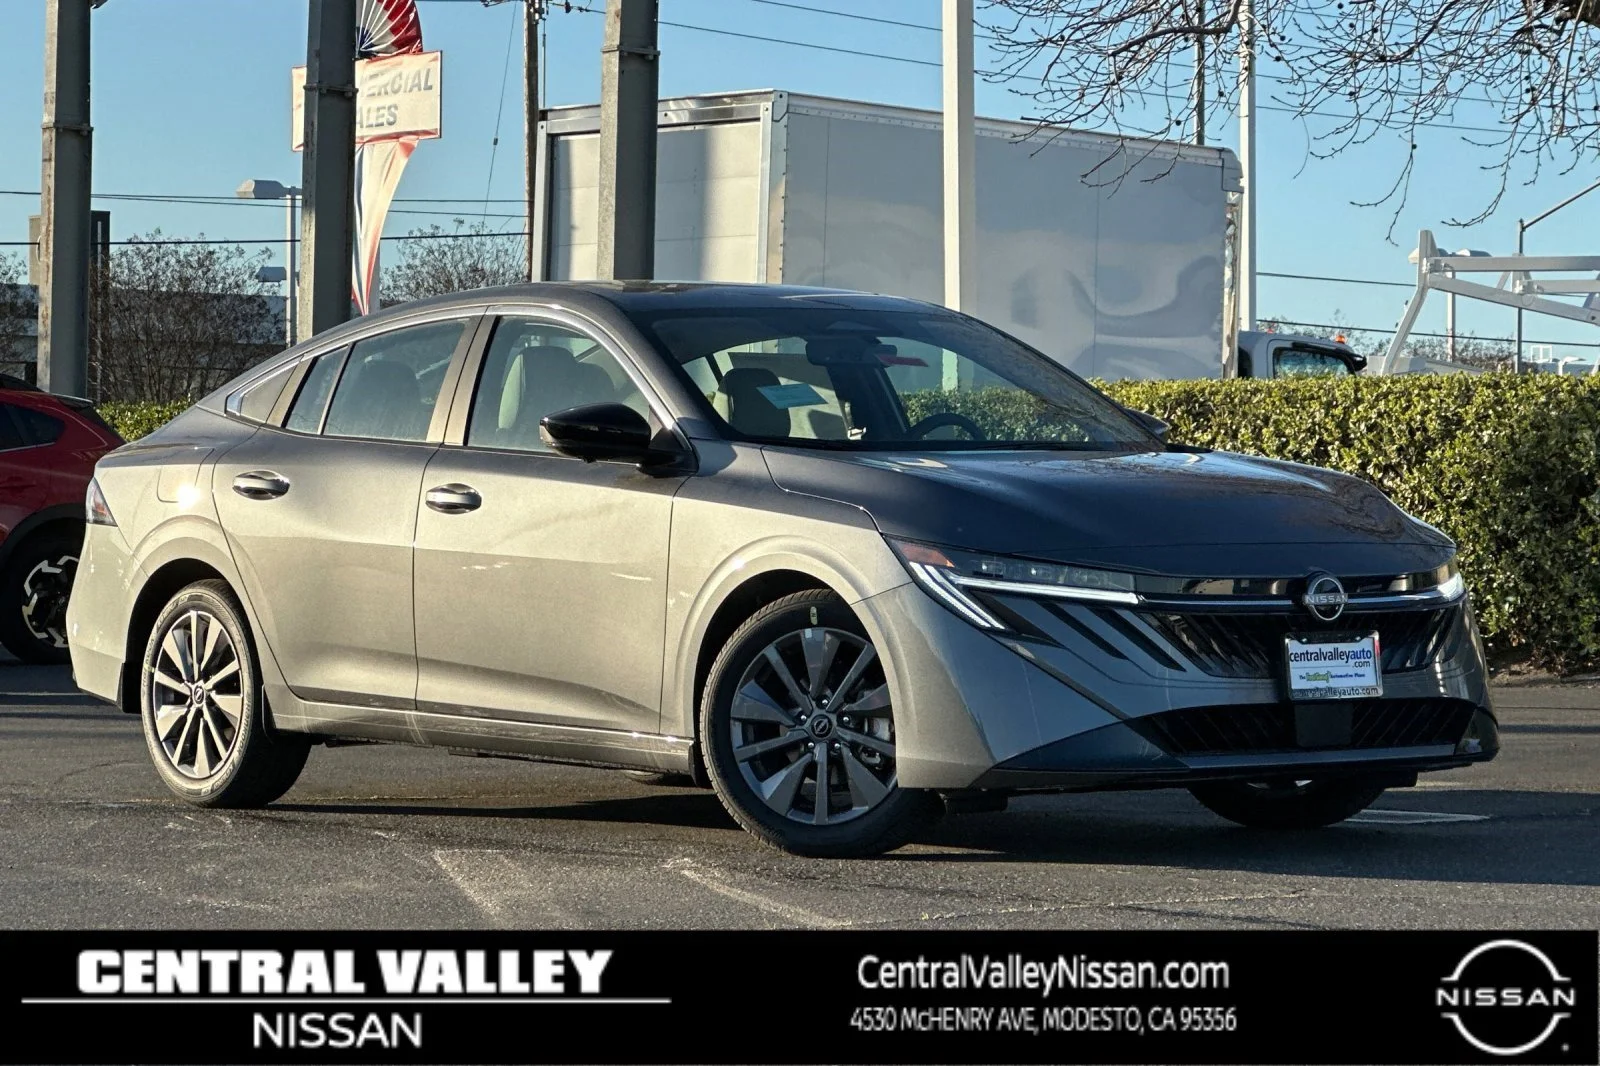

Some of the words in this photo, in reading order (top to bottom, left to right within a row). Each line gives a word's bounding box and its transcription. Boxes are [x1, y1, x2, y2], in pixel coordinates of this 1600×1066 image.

[359, 68, 433, 98] ERCIAL
[356, 103, 398, 129] ALES
[1306, 595, 1348, 603] NISSAN
[1289, 648, 1372, 664] centralvalleyauto
[1353, 661, 1370, 669] .com
